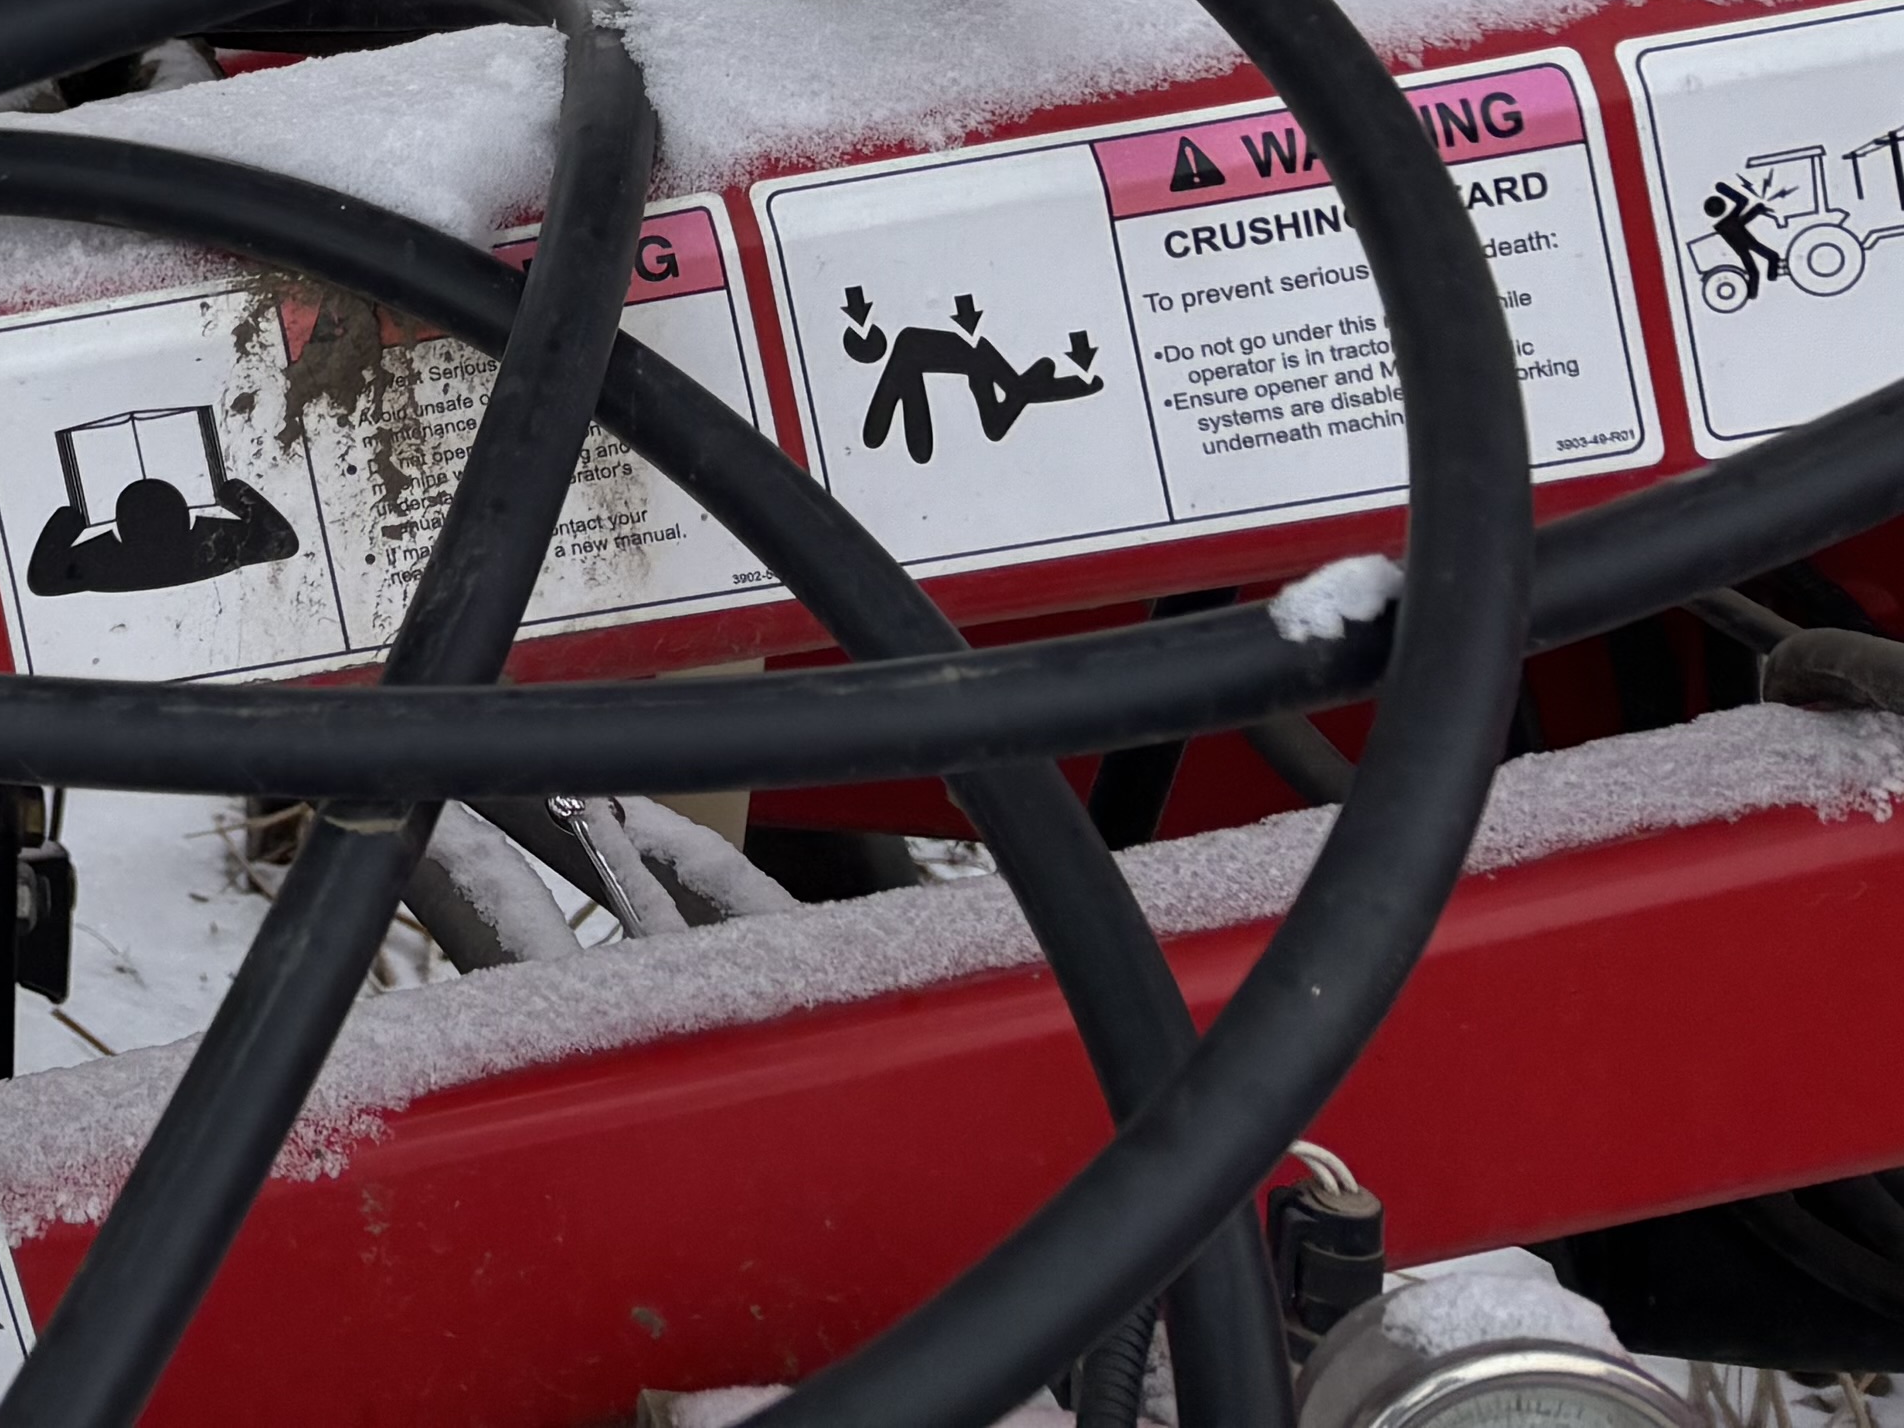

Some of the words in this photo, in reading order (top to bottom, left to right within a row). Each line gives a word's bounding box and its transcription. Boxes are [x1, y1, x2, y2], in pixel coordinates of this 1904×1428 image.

[1241, 92, 1524, 178] WING
[1143, 293, 1173, 313] To
[1181, 276, 1273, 312] prevent
[1281, 264, 1370, 292] serious
[1483, 232, 1558, 258] death:
[1164, 345, 1194, 363] Do
[1201, 338, 1233, 357] not
[1241, 334, 1265, 355] go
[1273, 324, 1333, 346] under
[1339, 316, 1377, 337] this
[428, 360, 498, 381] Serious
[1189, 357, 1276, 386] operator
[1282, 355, 1299, 370] is
[1306, 348, 1325, 366] in
[1330, 340, 1391, 361] tracto
[1174, 389, 1248, 411] Ensure
[1255, 373, 1328, 399] opener
[1335, 364, 1374, 383] and
[1198, 403, 1284, 433] systems
[1291, 400, 1324, 416] are
[1331, 386, 1404, 410] disable
[1517, 358, 1580, 382] orking
[1202, 423, 1322, 455] underneath
[1329, 410, 1404, 436] machin
[554, 544, 567, 558] a
[571, 537, 607, 556] new
[614, 526, 687, 550] manual.
[607, 509, 648, 535] your
